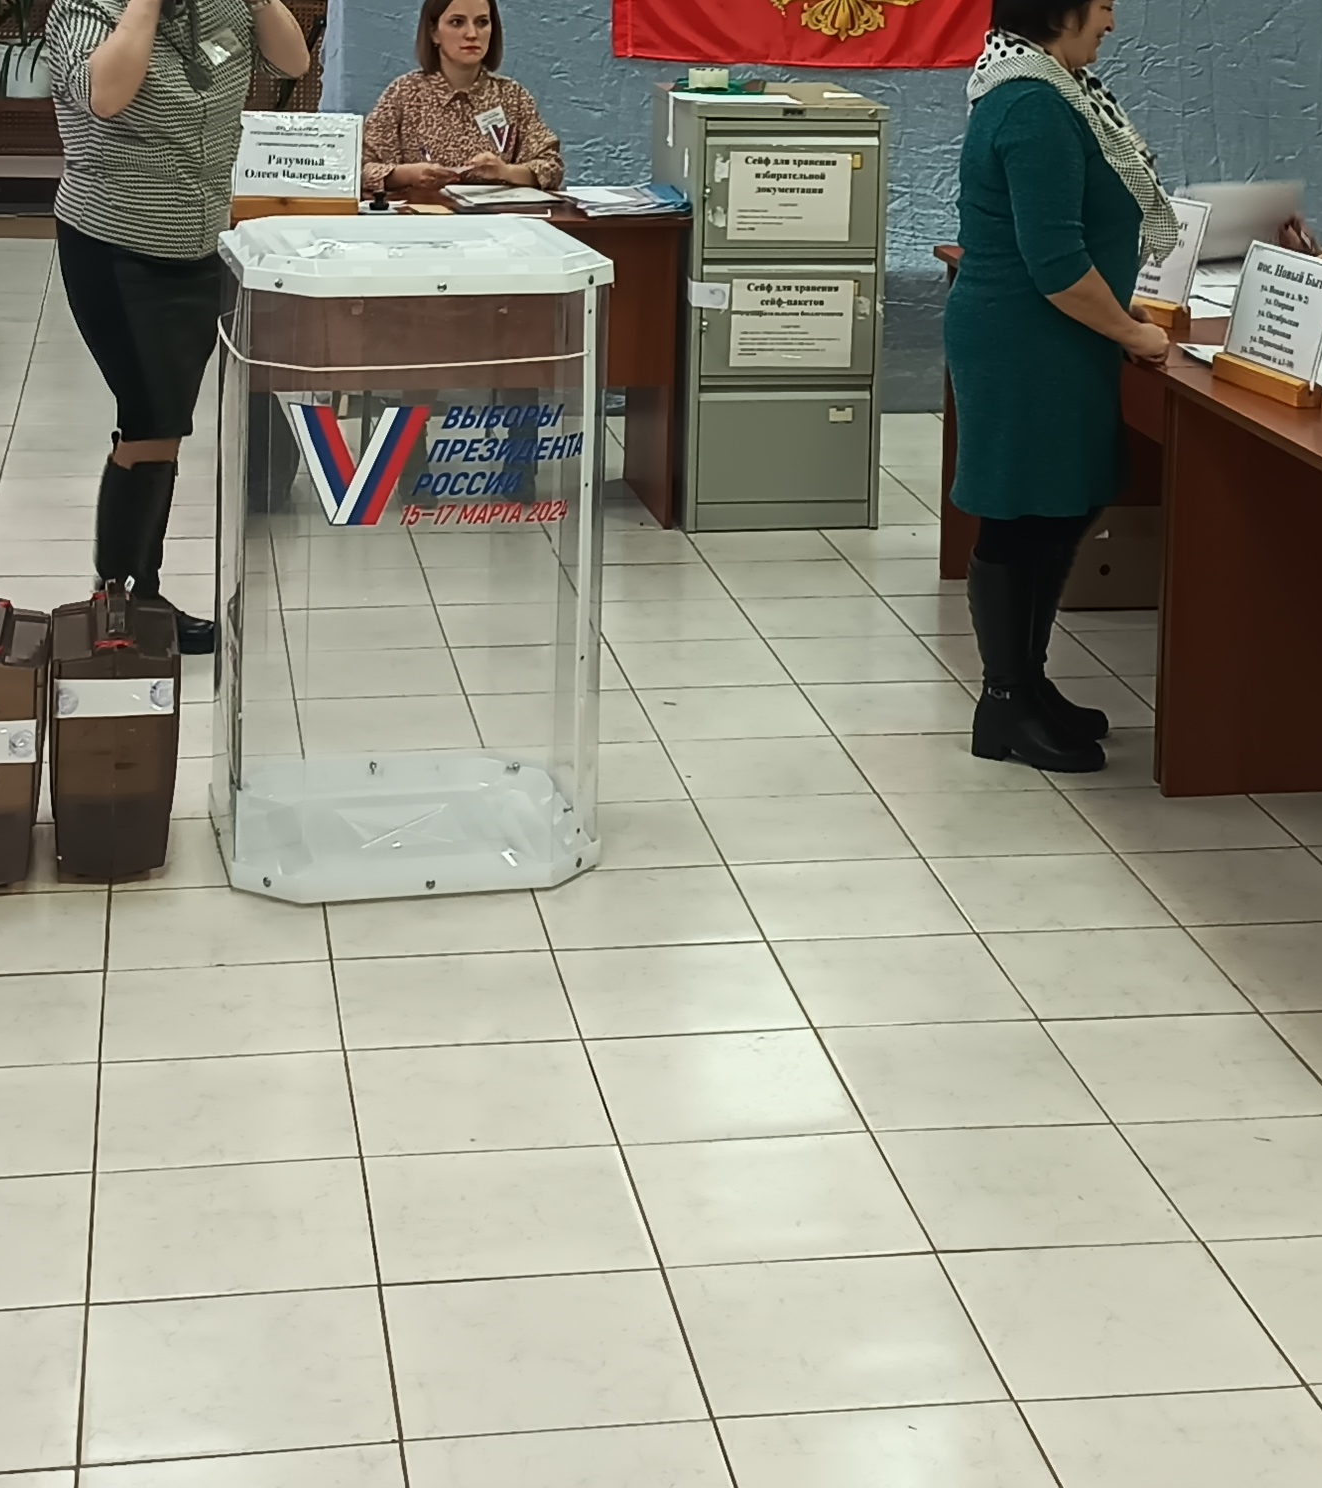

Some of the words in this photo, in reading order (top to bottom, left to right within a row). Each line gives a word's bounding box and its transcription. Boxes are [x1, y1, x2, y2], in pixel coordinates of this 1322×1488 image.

[745, 155, 771, 167] Сейф
[772, 158, 790, 166] для
[792, 158, 837, 167] хранения
[755, 171, 826, 181] избирательной
[755, 186, 824, 195] документации
[1257, 262, 1273, 275] пос.
[1274, 264, 1305, 283] Новый
[746, 283, 773, 294] Сейф
[794, 285, 839, 294] хранения
[760, 297, 825, 308] сейф-пакетов
[441, 403, 565, 430] ВЫБОРЫ
[427, 431, 584, 465] ПРЕЗИДЕНТА
[412, 471, 523, 497] РОССИИ
[456, 502, 523, 525] МАРТА
[524, 499, 569, 523] 2024
